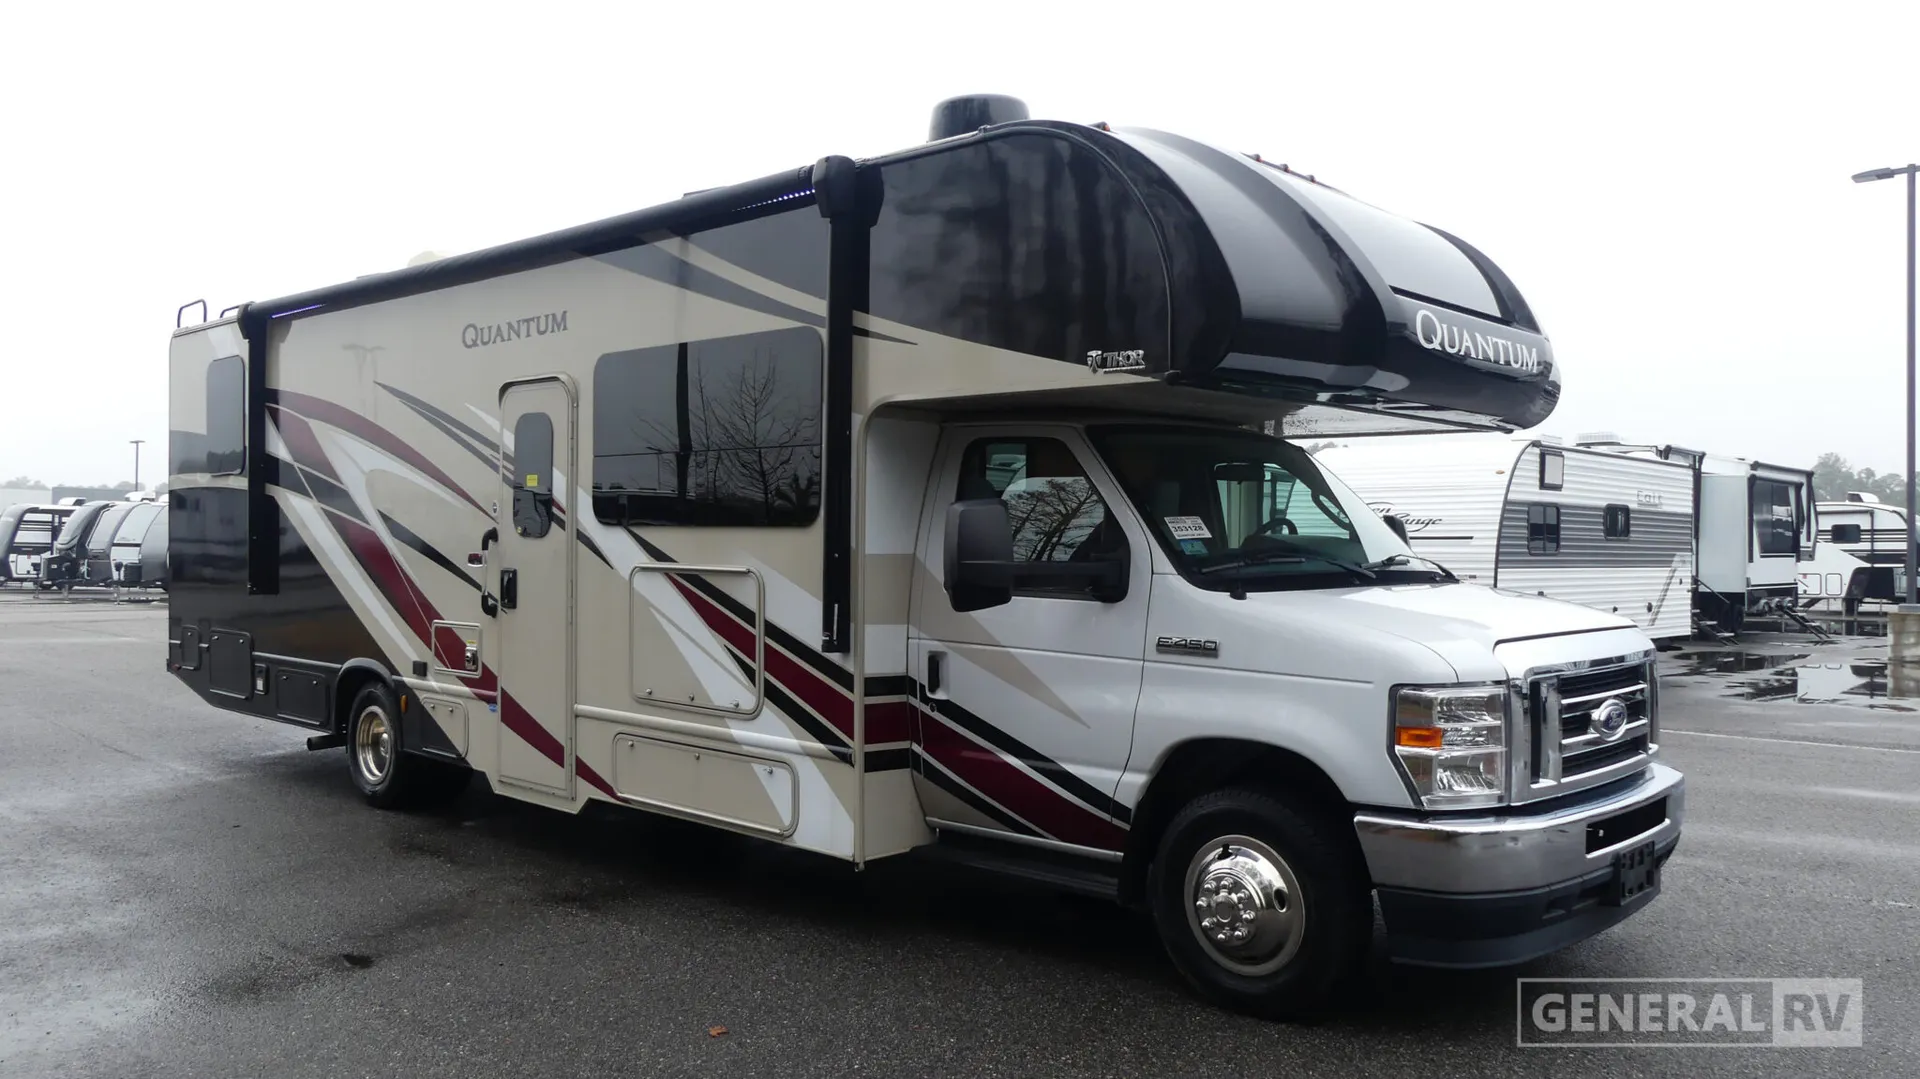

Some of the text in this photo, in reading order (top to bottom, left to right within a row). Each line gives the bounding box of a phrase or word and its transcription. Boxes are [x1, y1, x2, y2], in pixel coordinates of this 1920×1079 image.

[462, 310, 568, 349] QUANTUM
[1416, 309, 1537, 373] QUANTUM
[1103, 349, 1145, 367] THOR
